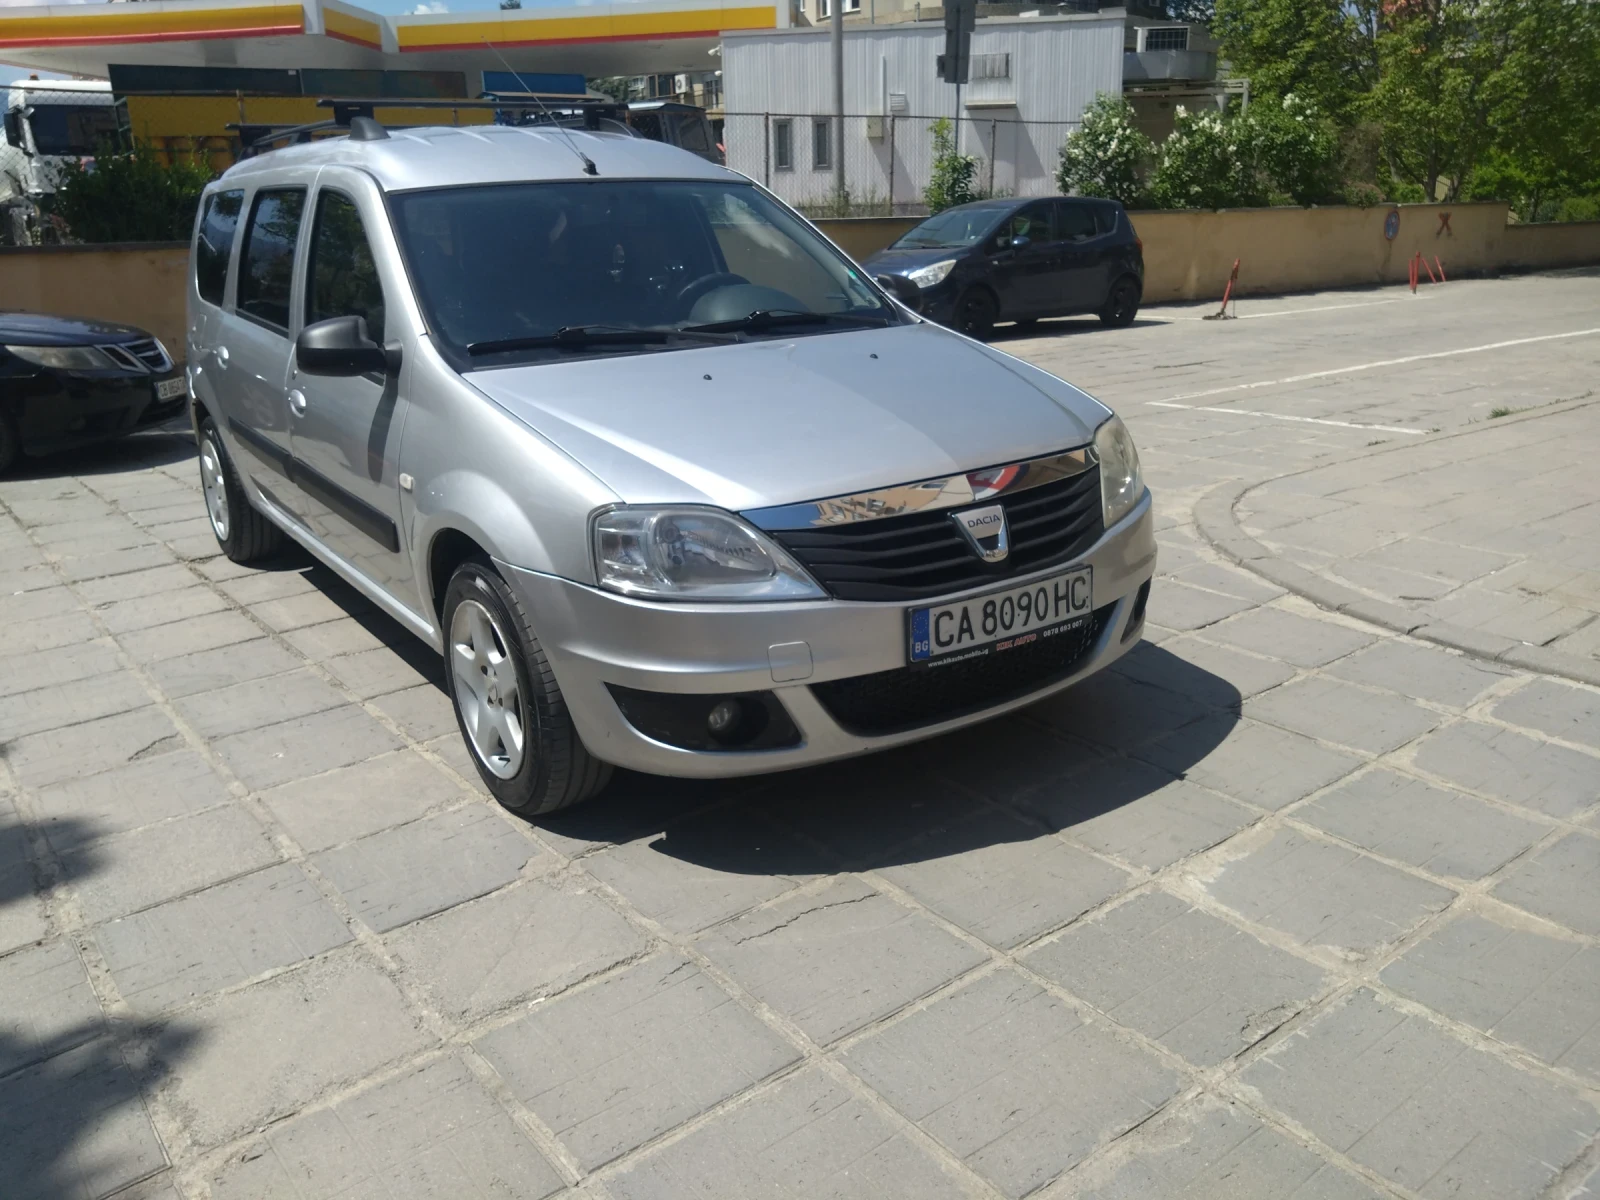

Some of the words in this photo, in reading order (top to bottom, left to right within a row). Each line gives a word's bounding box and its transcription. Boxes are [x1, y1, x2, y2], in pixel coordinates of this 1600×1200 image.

[967, 514, 1001, 528] DACIA
[934, 606, 975, 648] CA
[981, 586, 1049, 637] 8090
[1054, 576, 1087, 618] HC
[915, 640, 929, 653] BG
